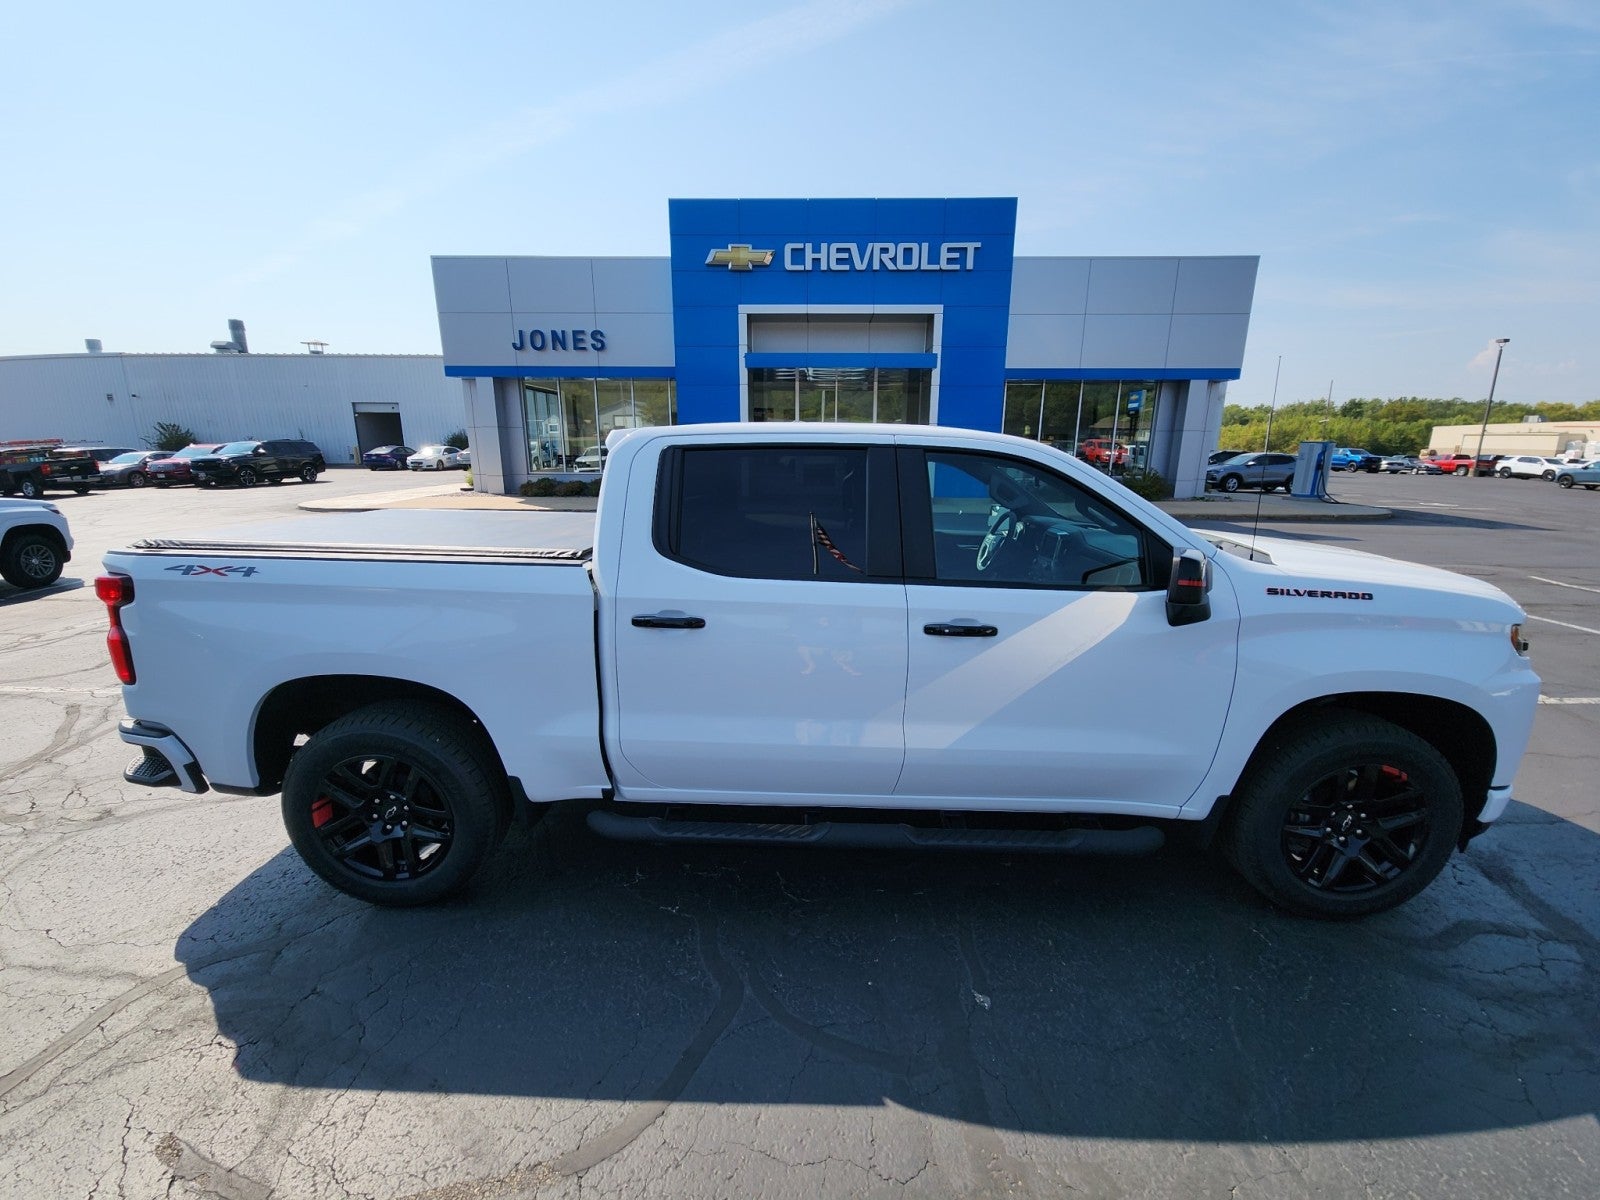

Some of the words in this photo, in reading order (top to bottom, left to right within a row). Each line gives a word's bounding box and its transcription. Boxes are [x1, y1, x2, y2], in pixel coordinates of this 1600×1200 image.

[784, 242, 981, 271] CHEVROLET
[512, 329, 606, 351] JONES
[1266, 588, 1373, 600] SILVERADO
